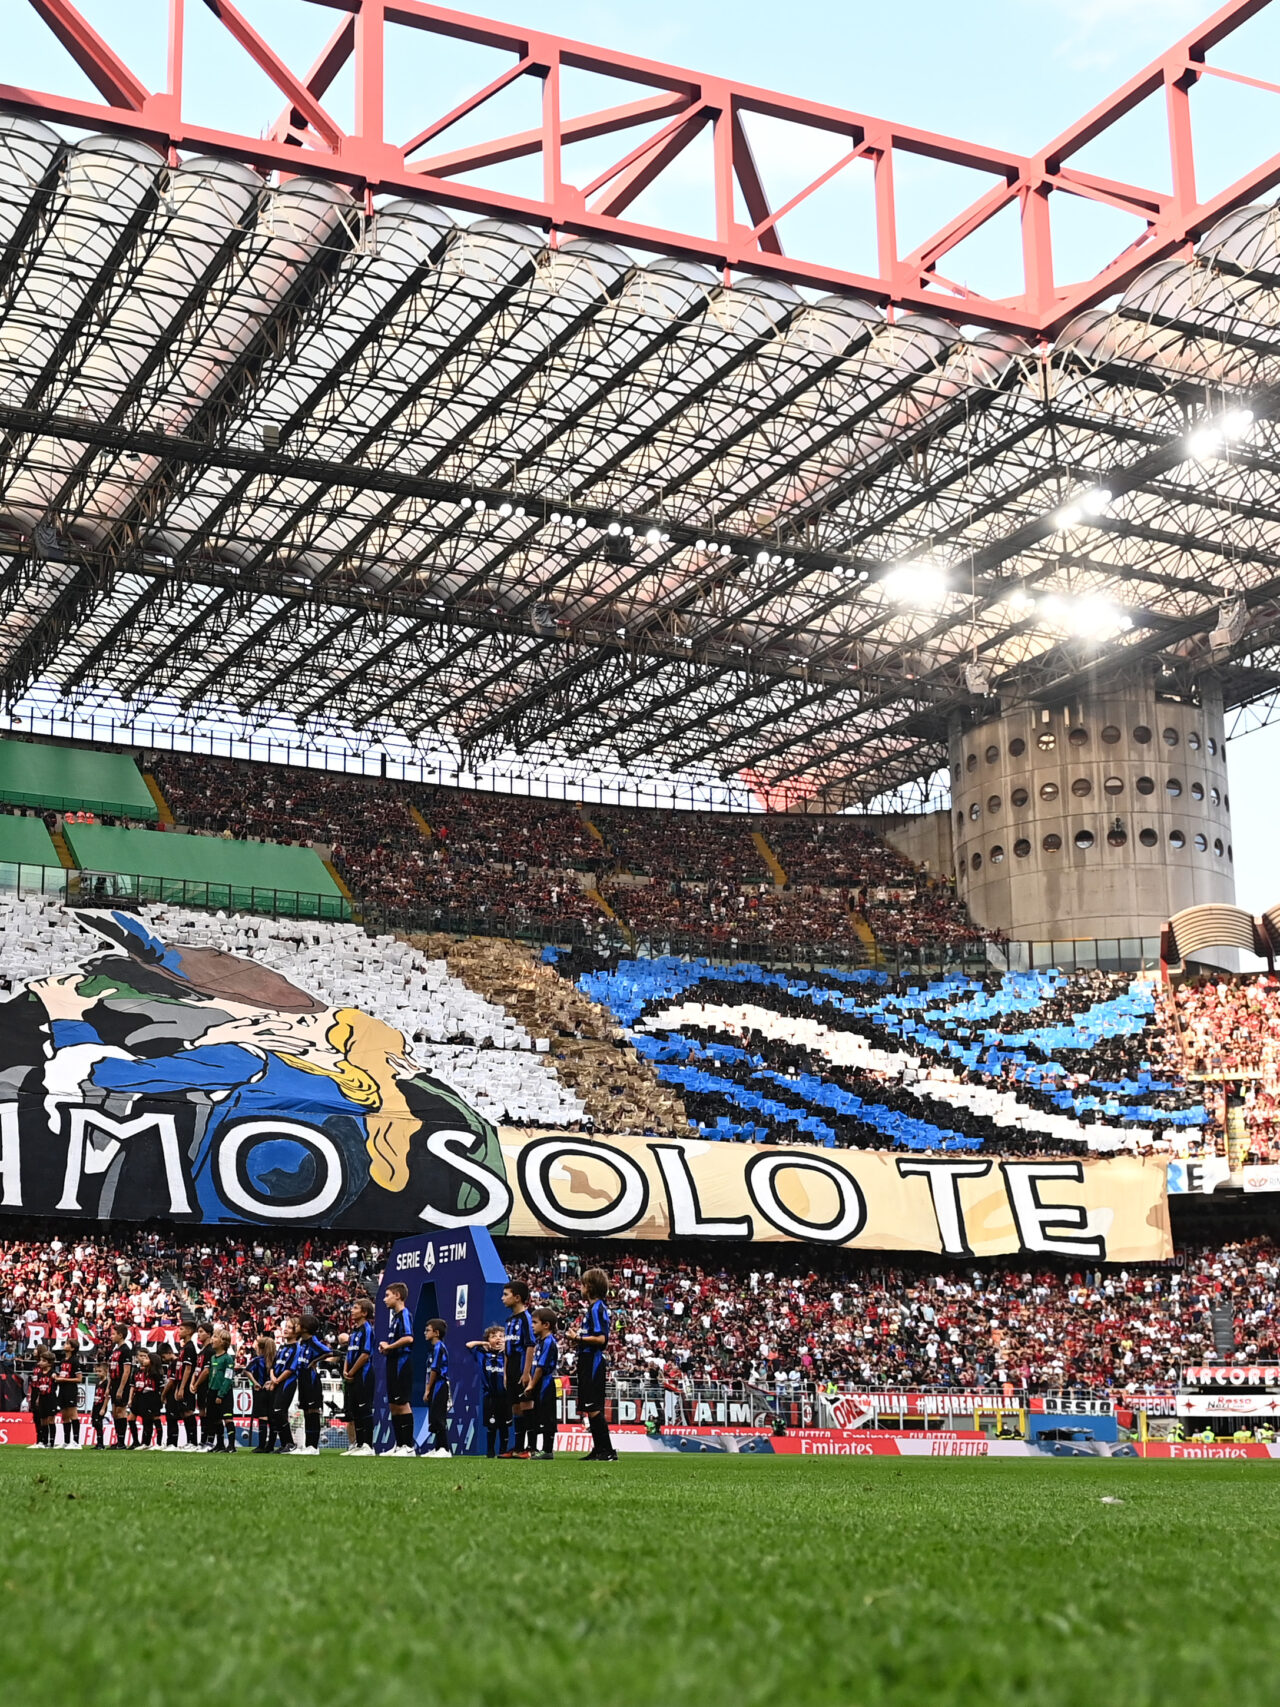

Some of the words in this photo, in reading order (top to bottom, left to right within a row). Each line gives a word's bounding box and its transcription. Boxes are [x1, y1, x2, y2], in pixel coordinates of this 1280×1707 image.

[418, 1128, 866, 1245] SOLO
[897, 1159, 1105, 1261] TE
[396, 1250, 421, 1271] SERIE
[449, 1242, 467, 1262] TIM
[26, 1325, 96, 1351] RED
[800, 1438, 873, 1455] Emirates
[1168, 1444, 1248, 1458] Emirates
